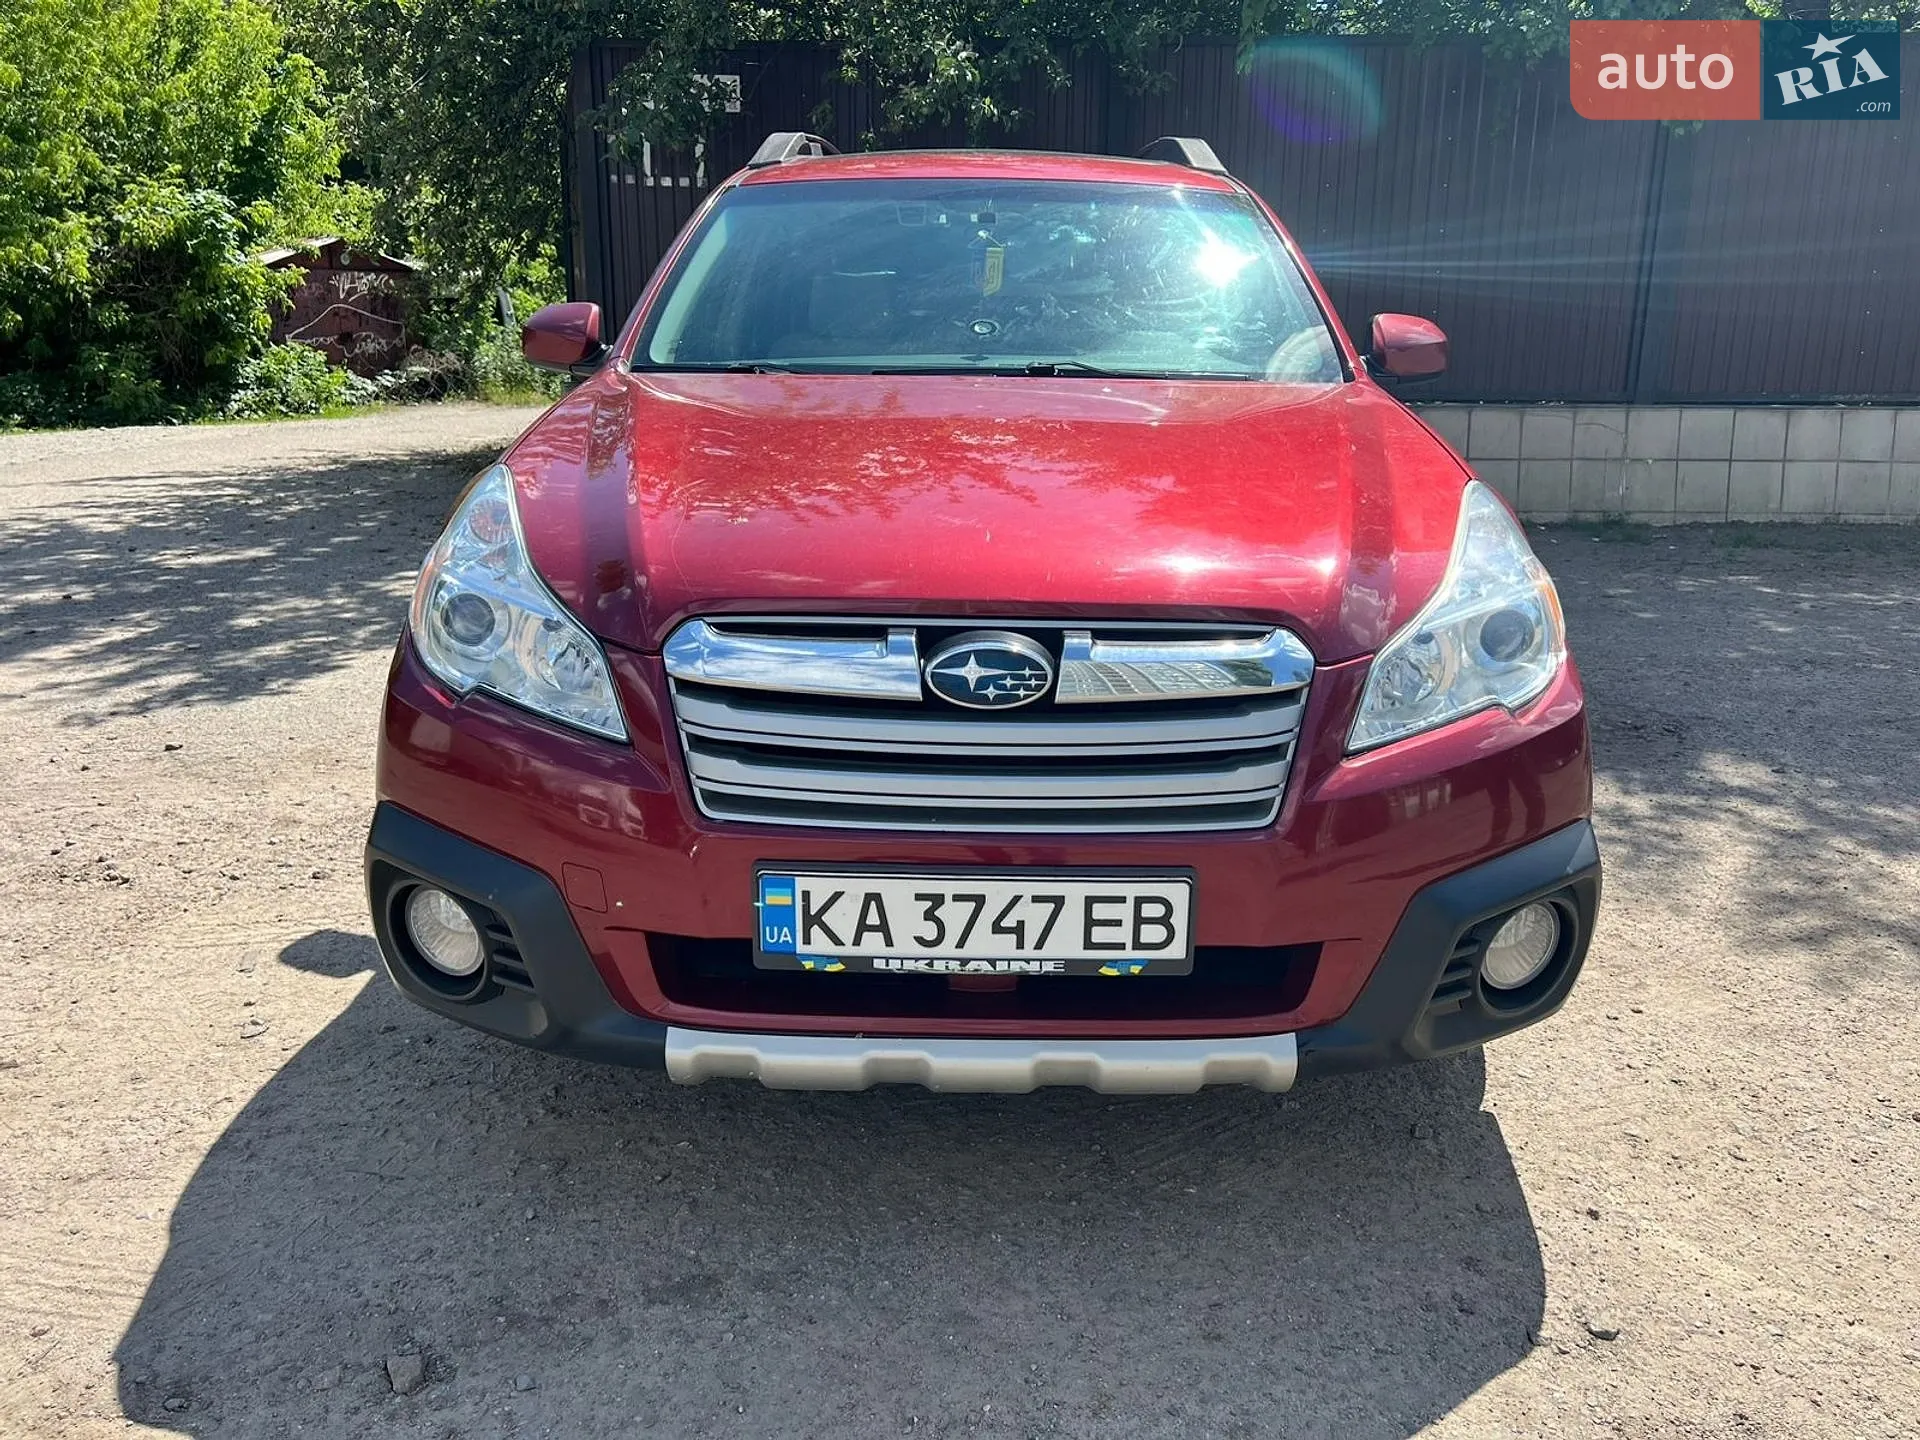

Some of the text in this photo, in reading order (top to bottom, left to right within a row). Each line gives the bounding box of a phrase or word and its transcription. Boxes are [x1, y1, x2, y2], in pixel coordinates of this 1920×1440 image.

[801, 890, 1177, 951] KA 3747 EB
[765, 927, 793, 944] UA
[872, 957, 1066, 973] UKRAINE
